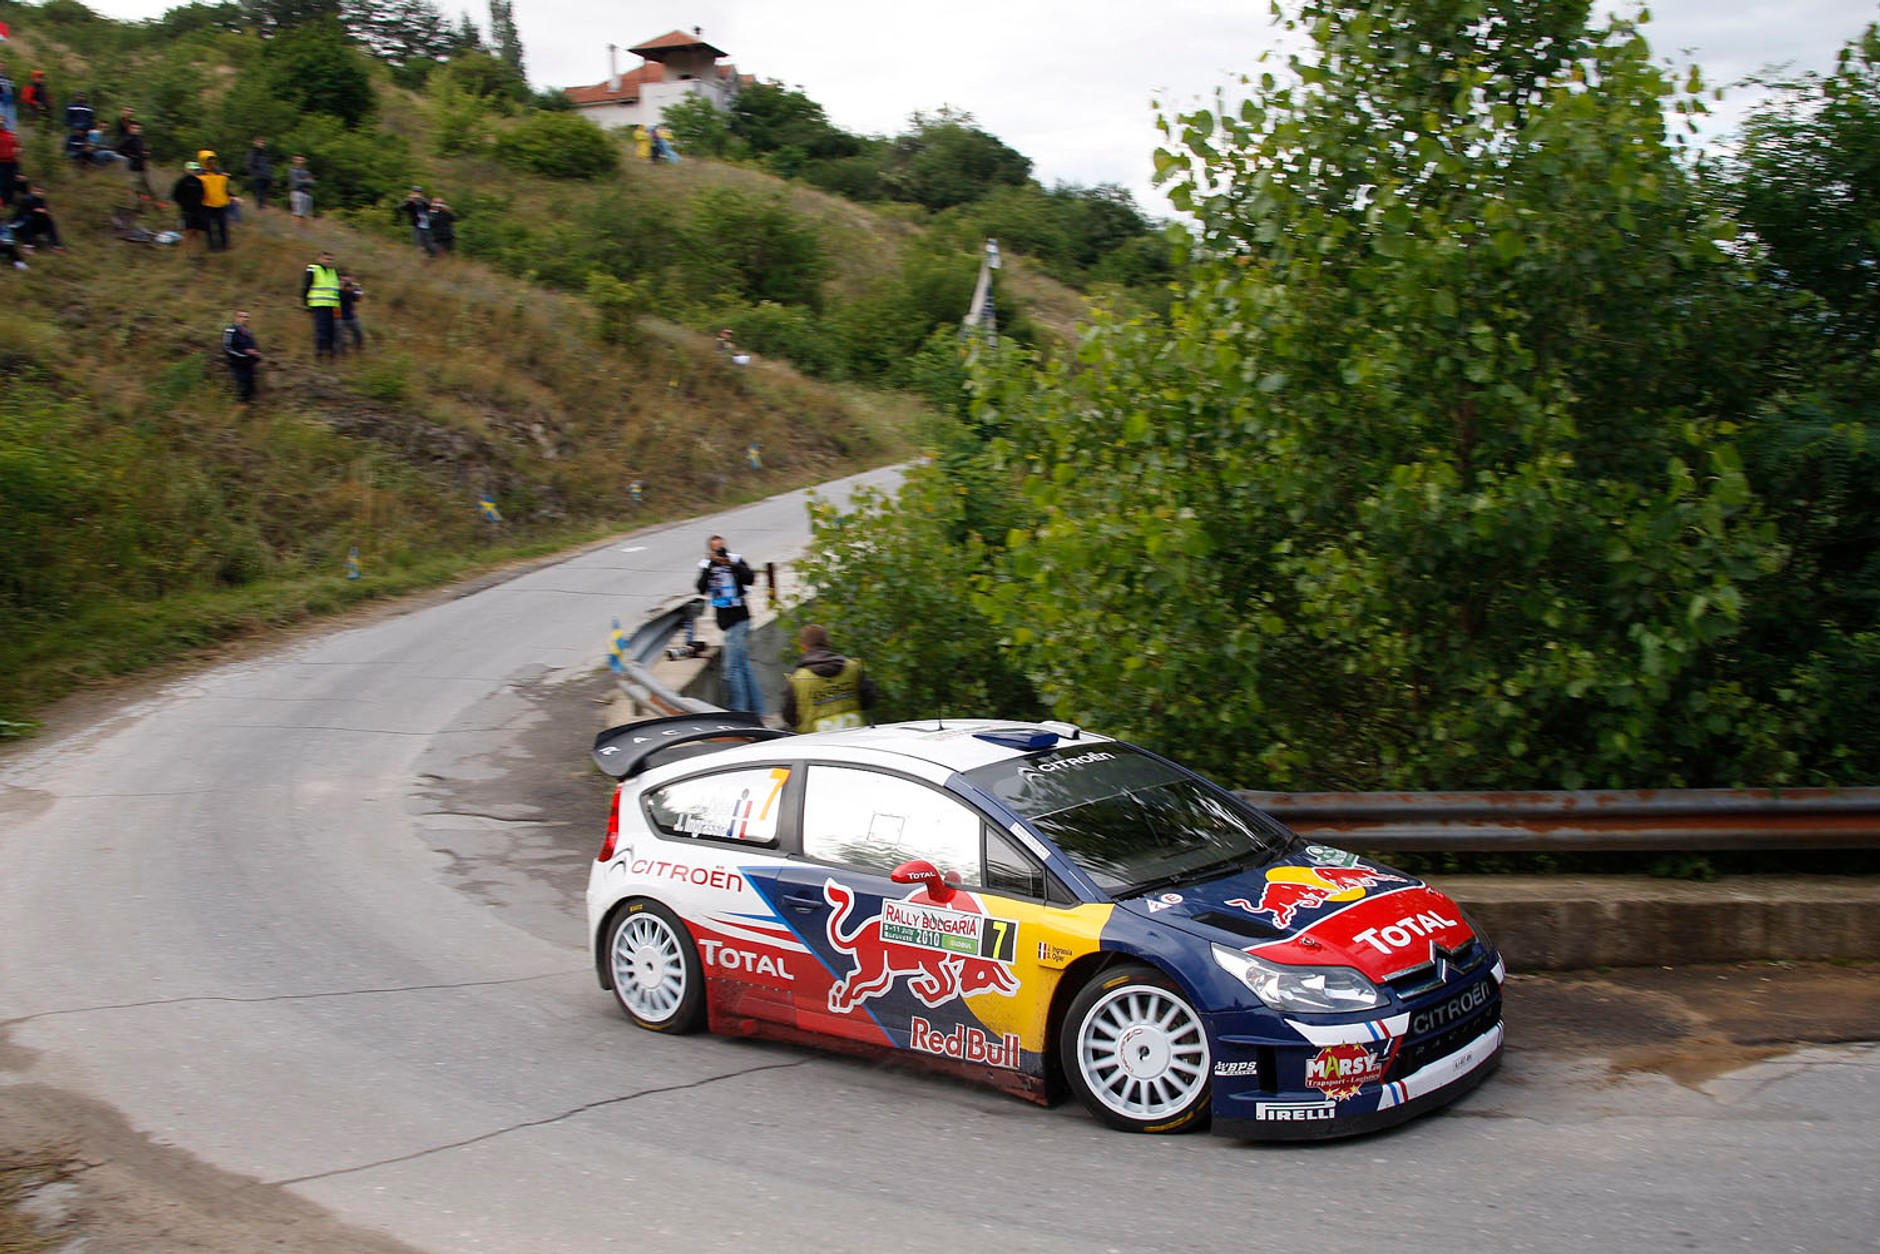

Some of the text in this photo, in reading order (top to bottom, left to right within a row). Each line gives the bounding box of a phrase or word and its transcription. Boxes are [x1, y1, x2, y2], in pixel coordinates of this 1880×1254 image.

[769, 767, 791, 821] 7
[907, 871, 936, 880] TOTAL
[886, 904, 977, 936] RALLY BULGARIA
[1352, 910, 1458, 955] TOTAL
[917, 929, 940, 947] 2010
[993, 921, 1008, 959] 7
[698, 938, 795, 980] TOTAL
[1256, 1100, 1336, 1120] PIRELLI
